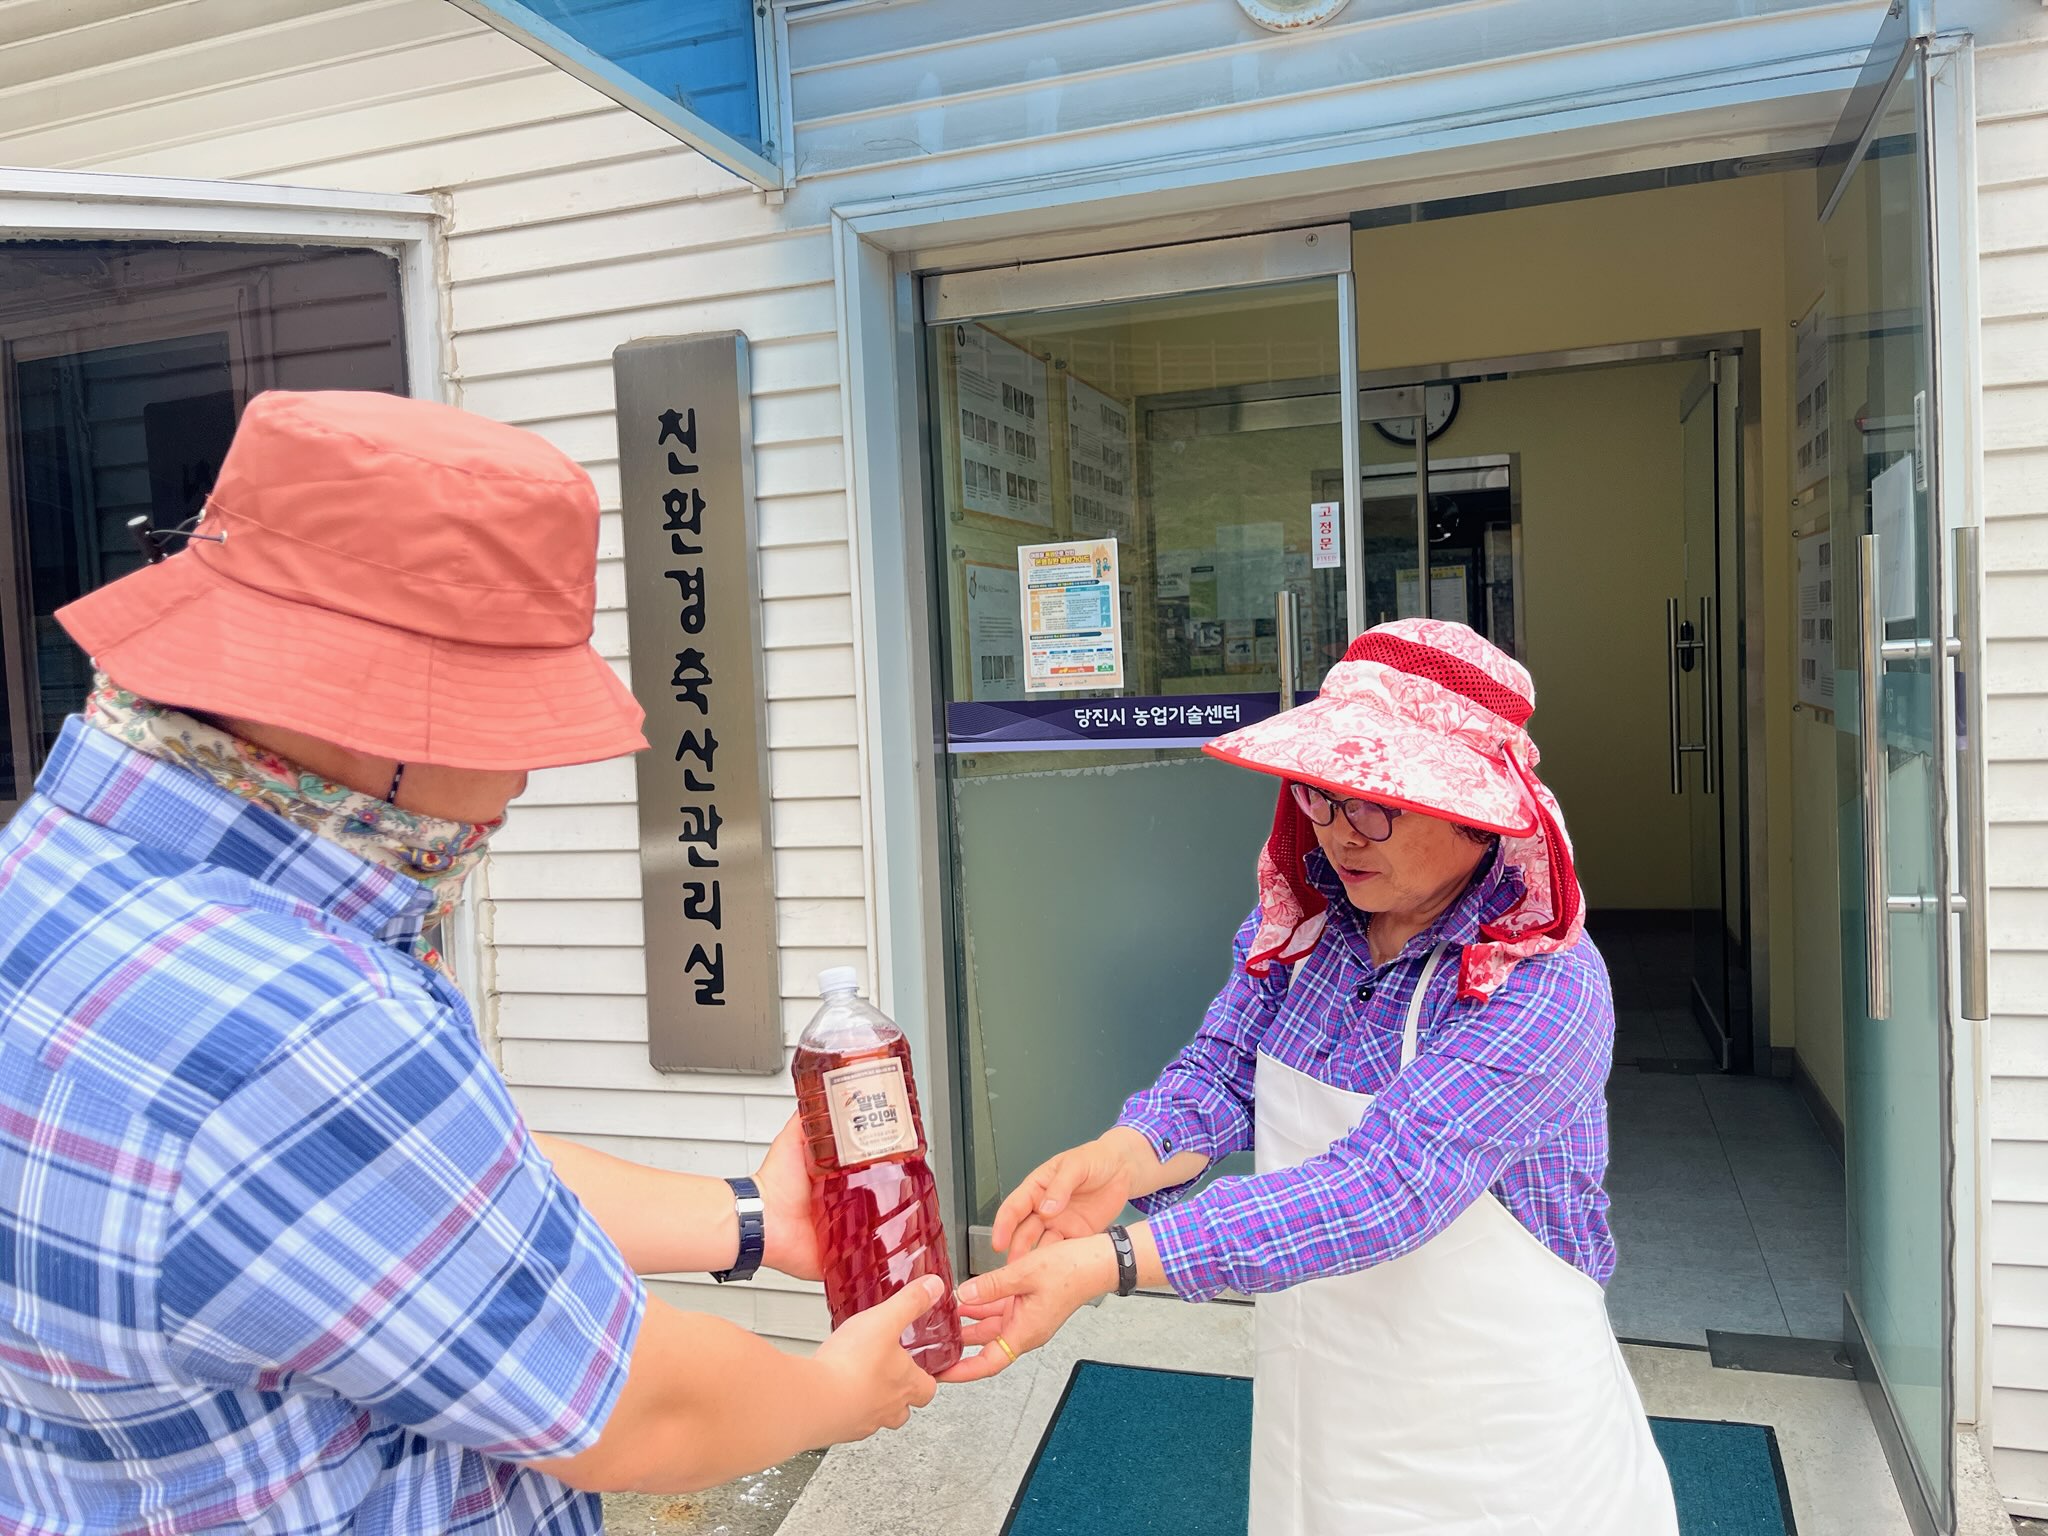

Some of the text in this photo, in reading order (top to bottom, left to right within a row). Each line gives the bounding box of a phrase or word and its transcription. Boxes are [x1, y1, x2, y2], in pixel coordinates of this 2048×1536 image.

[1319, 505, 1333, 551] 고정문
[657, 407, 727, 1007] 친환경축산관리실
[1074, 704, 1241, 728] 당진시 농업기술센터
[853, 1108, 898, 1132] 유인액
